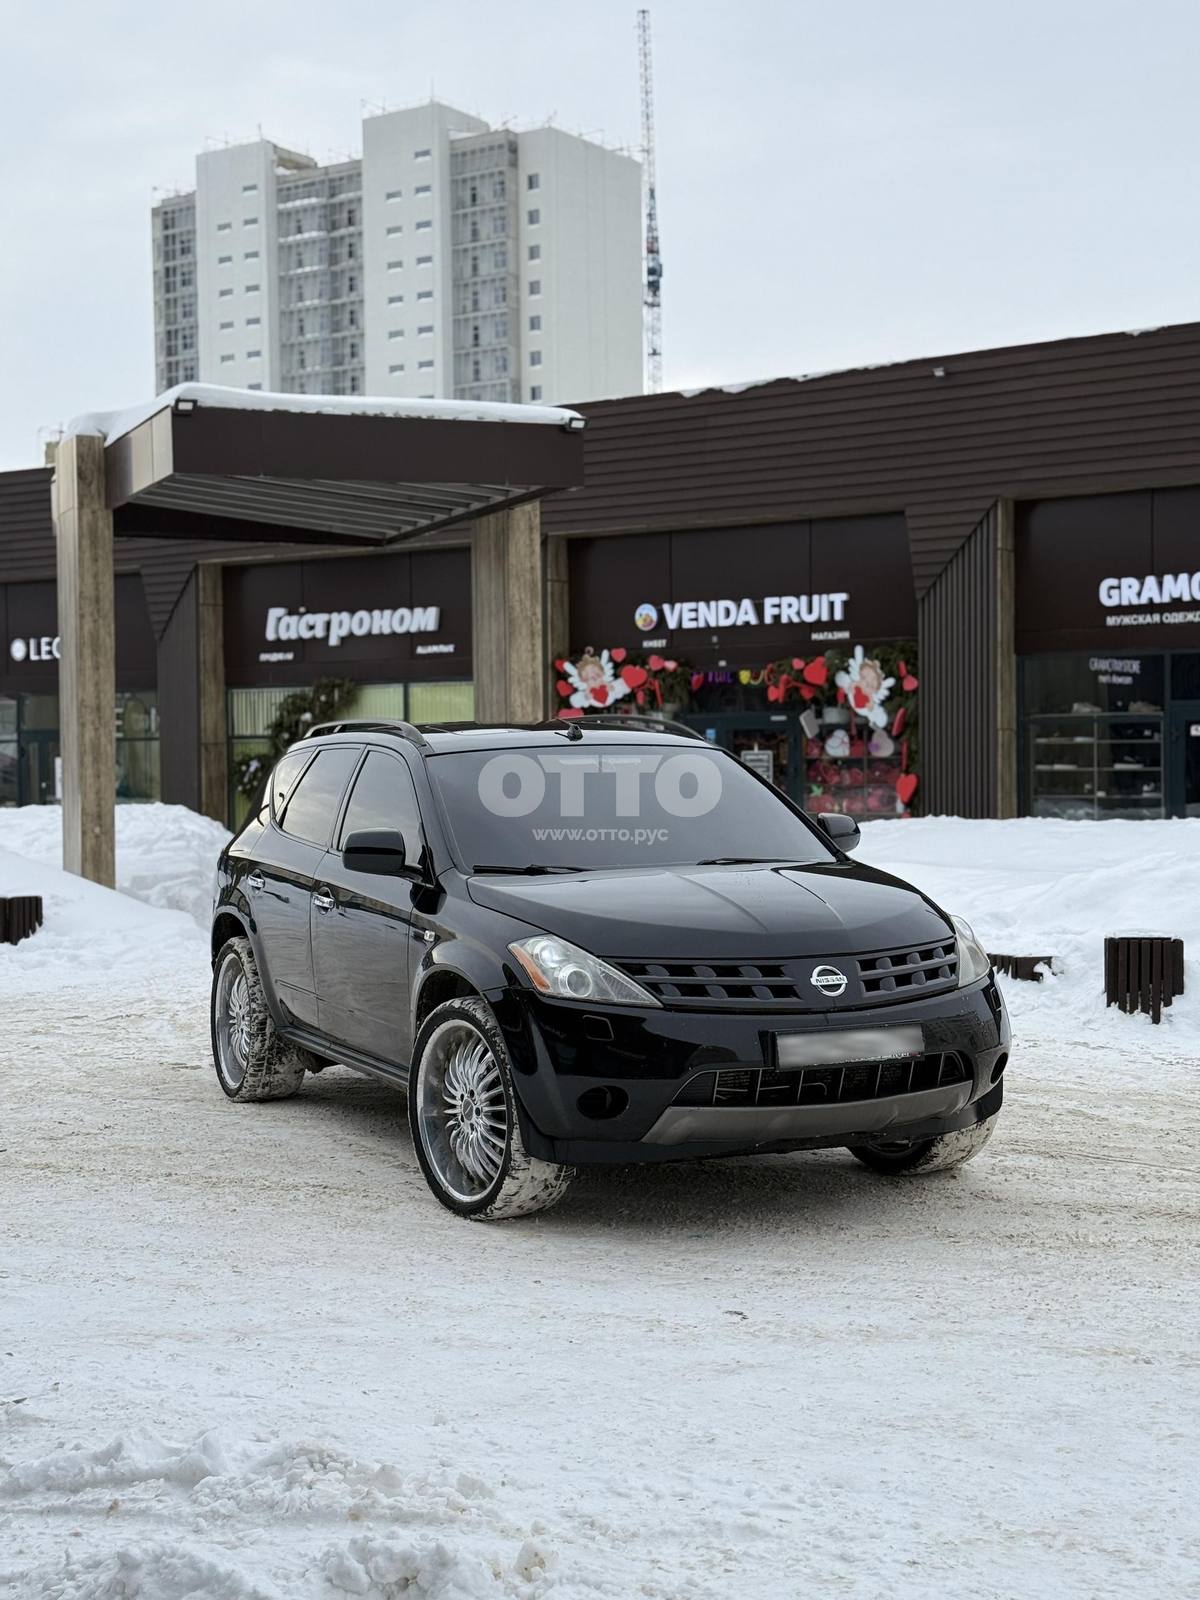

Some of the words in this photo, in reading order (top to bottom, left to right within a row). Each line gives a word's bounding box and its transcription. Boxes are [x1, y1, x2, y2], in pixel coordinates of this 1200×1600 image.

[662, 599, 759, 629] VENDA
[764, 593, 848, 624] FRUIT
[1106, 613, 1160, 626] МУЖСКАЯ
[265, 606, 439, 646] Гастроном
[815, 976, 845, 984] NISSAN
